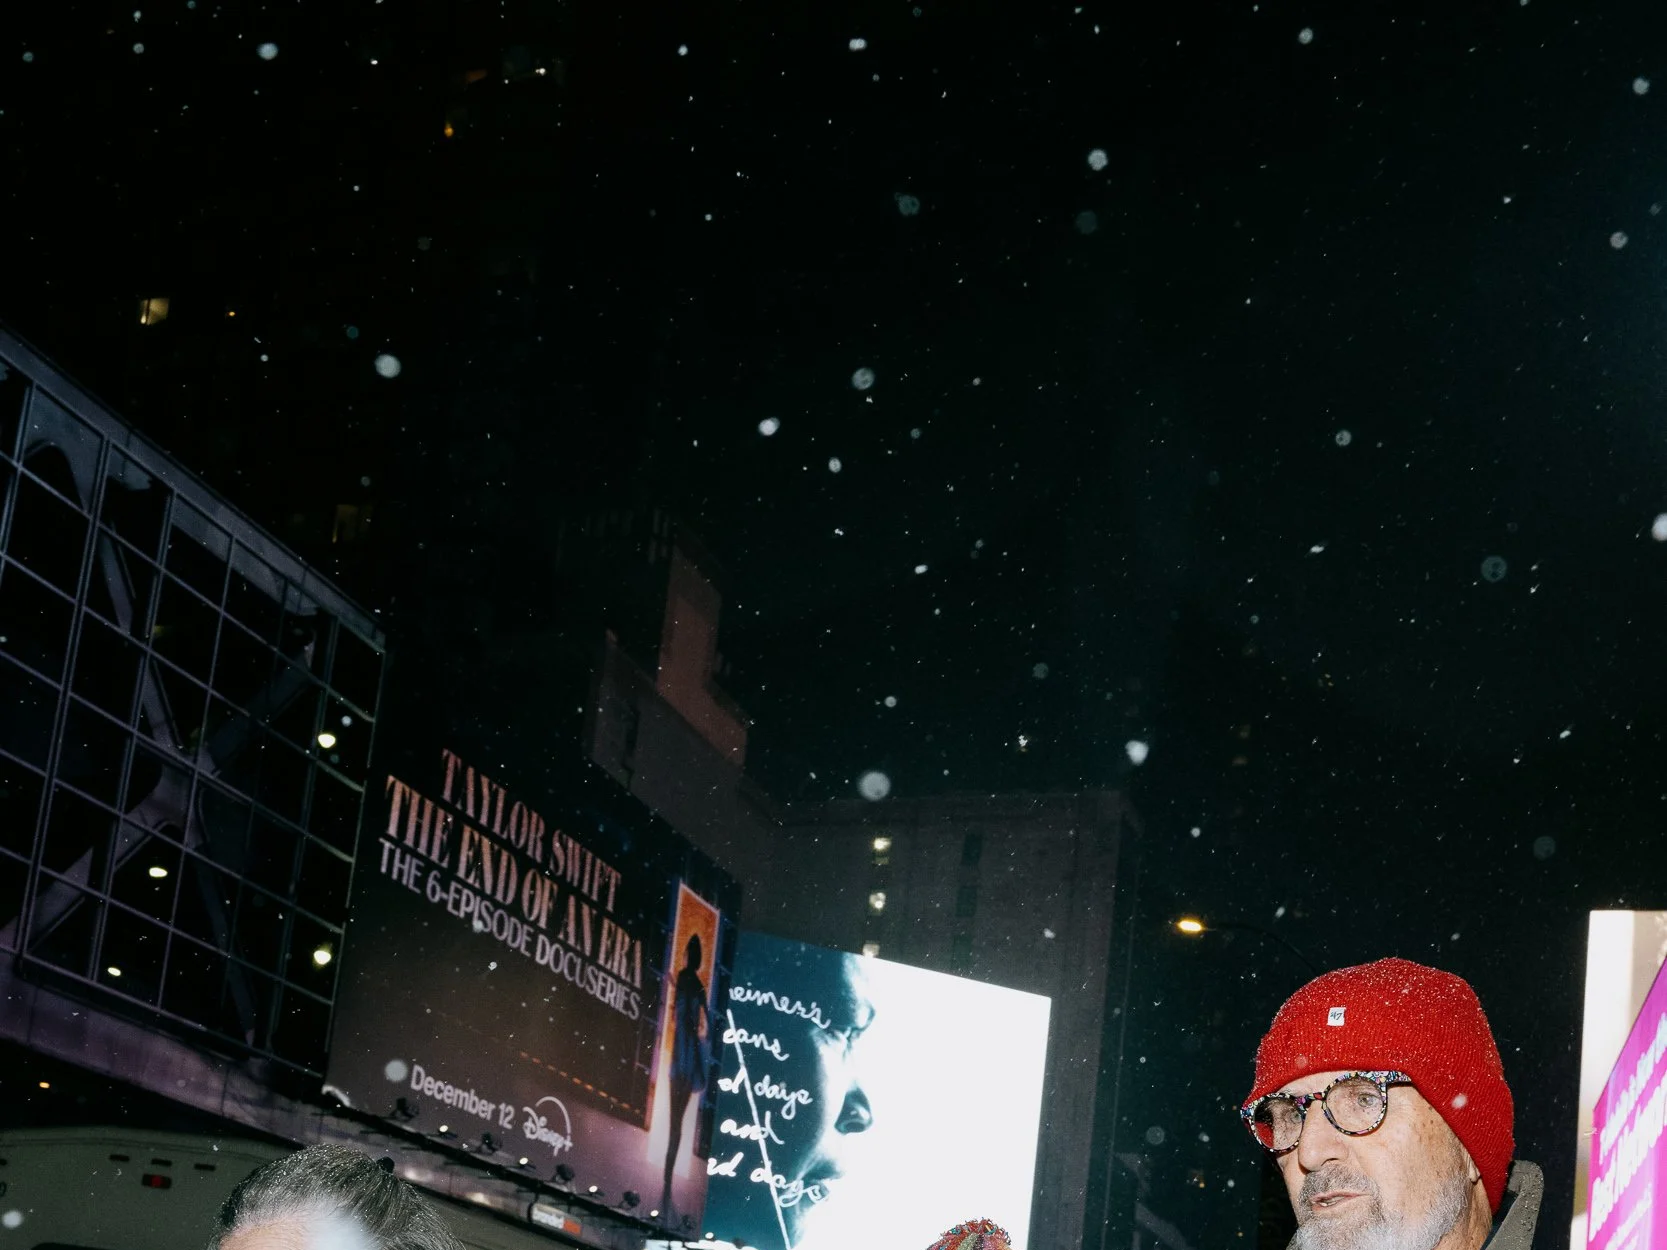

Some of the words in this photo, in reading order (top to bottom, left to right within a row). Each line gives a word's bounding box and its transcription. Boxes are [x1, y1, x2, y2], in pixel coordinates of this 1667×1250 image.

[385, 774, 453, 868] THE
[456, 823, 518, 906] END
[521, 868, 559, 929] OF
[558, 895, 597, 957] AN
[598, 916, 642, 989] ERA
[442, 748, 546, 863] TAYLOR
[550, 829, 622, 913] SWIFT
[379, 837, 425, 895] THE
[425, 869, 535, 957] 6-EPISODE
[534, 933, 641, 1021] DOCUSERIES
[411, 1064, 496, 1121] December
[498, 1102, 515, 1130] 12
